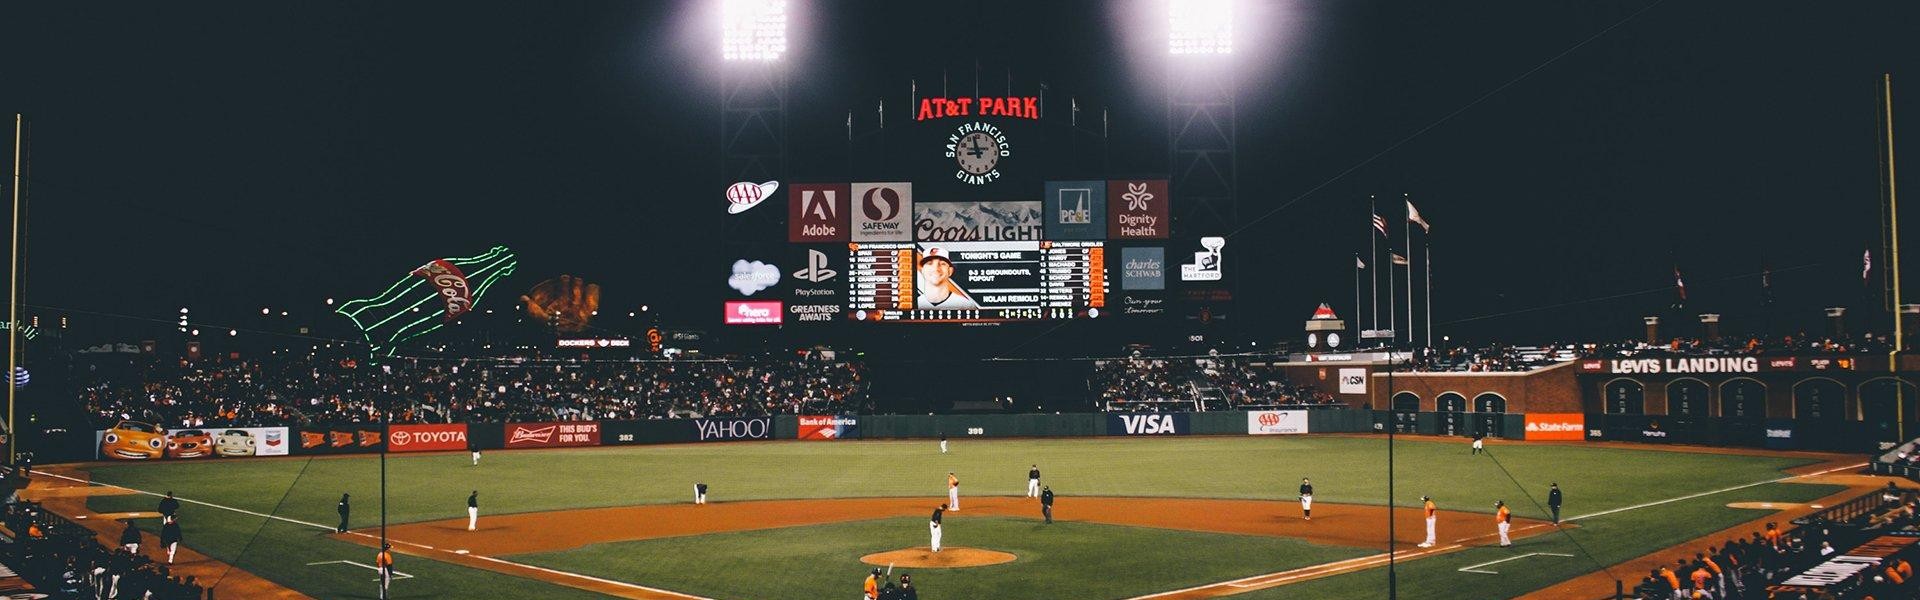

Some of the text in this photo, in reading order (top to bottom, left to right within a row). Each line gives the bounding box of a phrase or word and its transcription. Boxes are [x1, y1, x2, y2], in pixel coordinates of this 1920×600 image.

[918, 97, 1038, 120] AT&T PARK
[946, 121, 1010, 158] SAN FRANCISCO
[956, 169, 1000, 184] GIANTS
[1119, 214, 1157, 226] Dignity
[802, 225, 835, 236] Adobe
[916, 219, 1042, 241] Coors LIGHT
[1122, 227, 1156, 236] Health
[1125, 259, 1160, 269] charles
[795, 289, 834, 297] PlayStation
[791, 305, 839, 313] GREATNESS
[1666, 357, 1758, 372] LANDING
[1350, 376, 1364, 384] CSN
[576, 424, 598, 432] BUD'S
[696, 418, 770, 440] YAHOO!
[1119, 415, 1176, 434] VISA
[413, 432, 466, 442] TOYOTA
